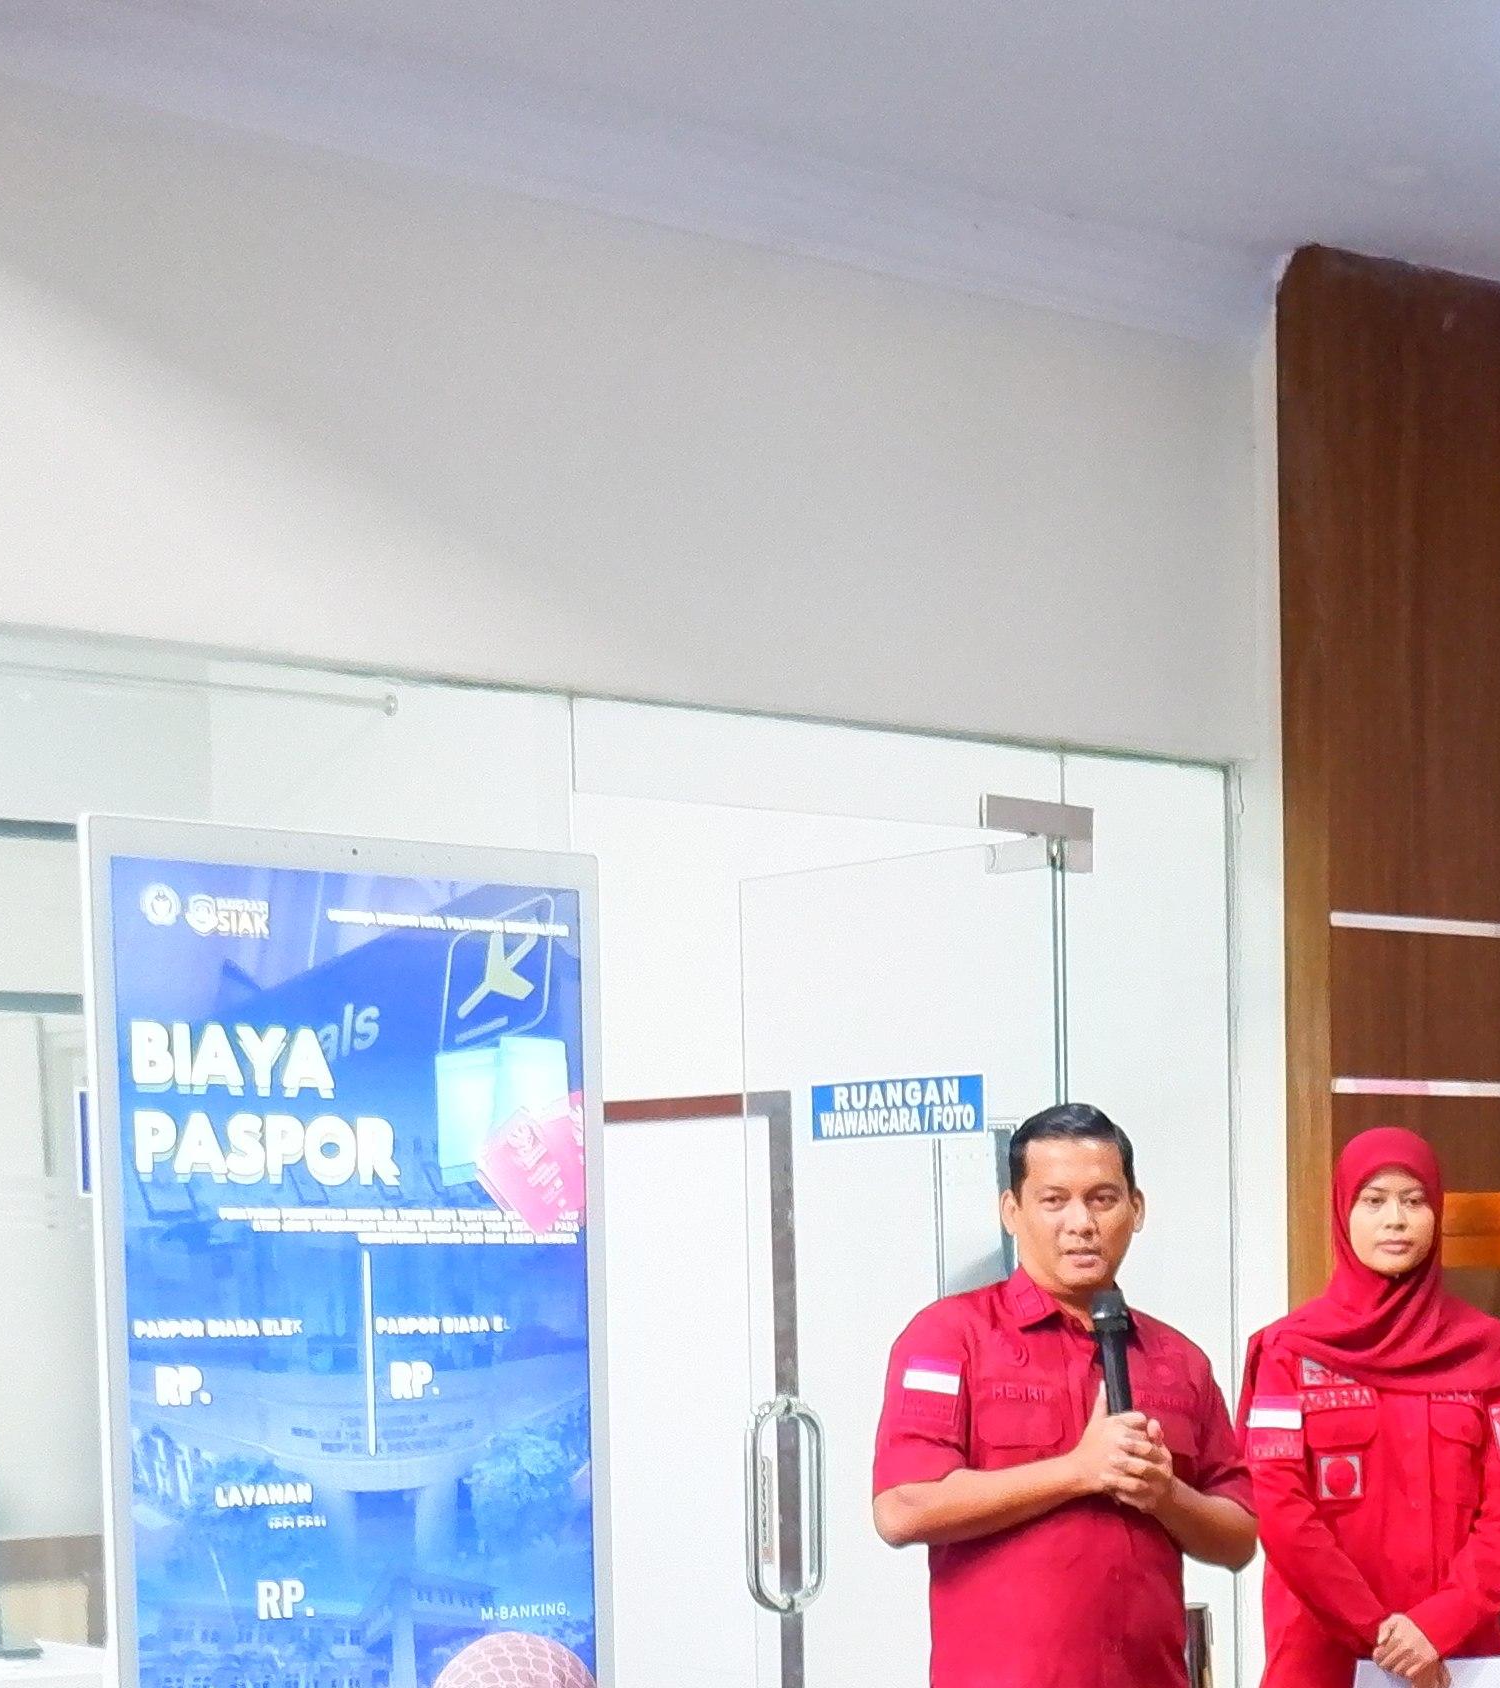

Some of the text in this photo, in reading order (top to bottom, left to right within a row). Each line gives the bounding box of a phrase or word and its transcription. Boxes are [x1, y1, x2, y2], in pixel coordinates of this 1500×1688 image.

[216, 912, 271, 940] SIAK
[130, 1019, 336, 1099] BIAYA
[833, 1078, 960, 1111] RUANGAN
[819, 1106, 922, 1138] WAWANCARA
[932, 1104, 977, 1131] FOTO
[132, 1108, 402, 1188] PASPOR
[153, 1364, 215, 1408] RP.
[388, 1360, 442, 1401] RP.
[214, 1481, 315, 1510] LAYANAN
[255, 1578, 316, 1622] RP.
